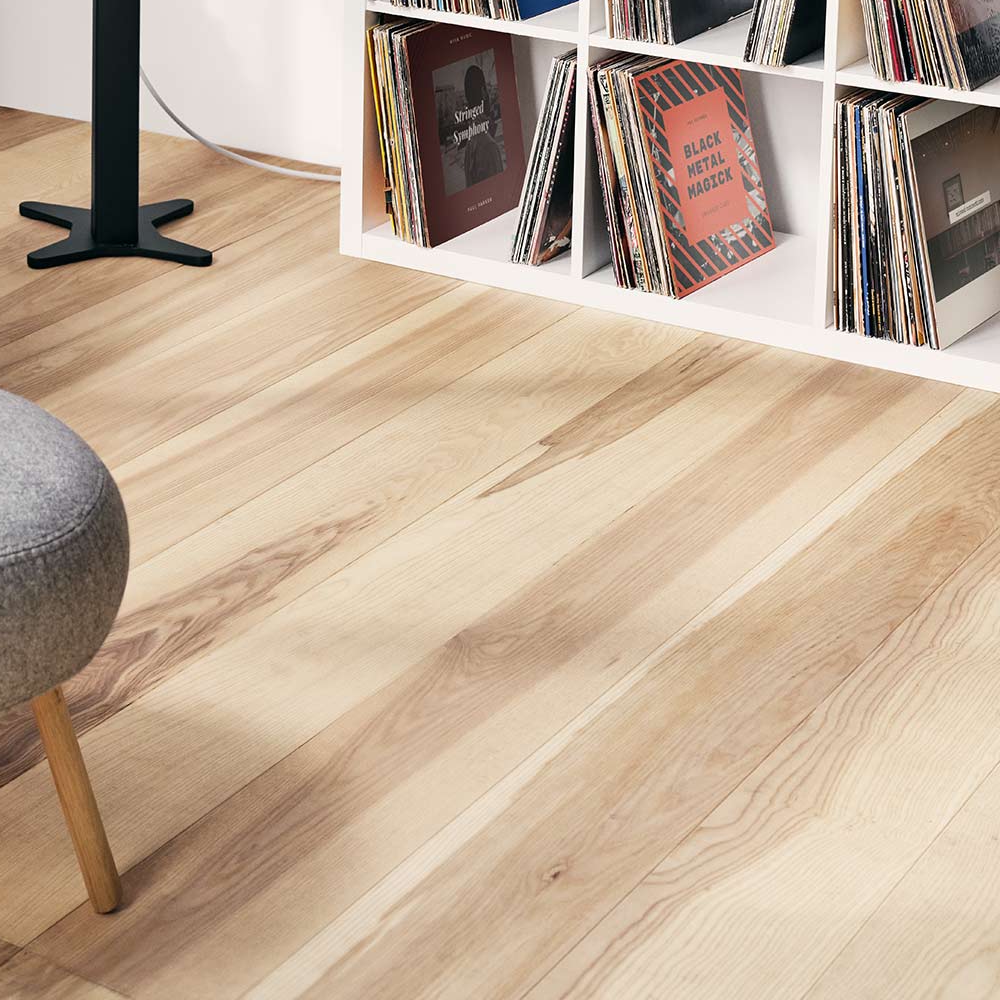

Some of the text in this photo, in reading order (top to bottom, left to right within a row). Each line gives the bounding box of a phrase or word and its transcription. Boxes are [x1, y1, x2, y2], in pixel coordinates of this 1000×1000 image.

[454, 99, 484, 125] Stringed
[452, 119, 490, 146] Symphony
[683, 130, 722, 160] BLACK
[687, 150, 725, 179] METAL
[687, 166, 734, 200] MAGICK
